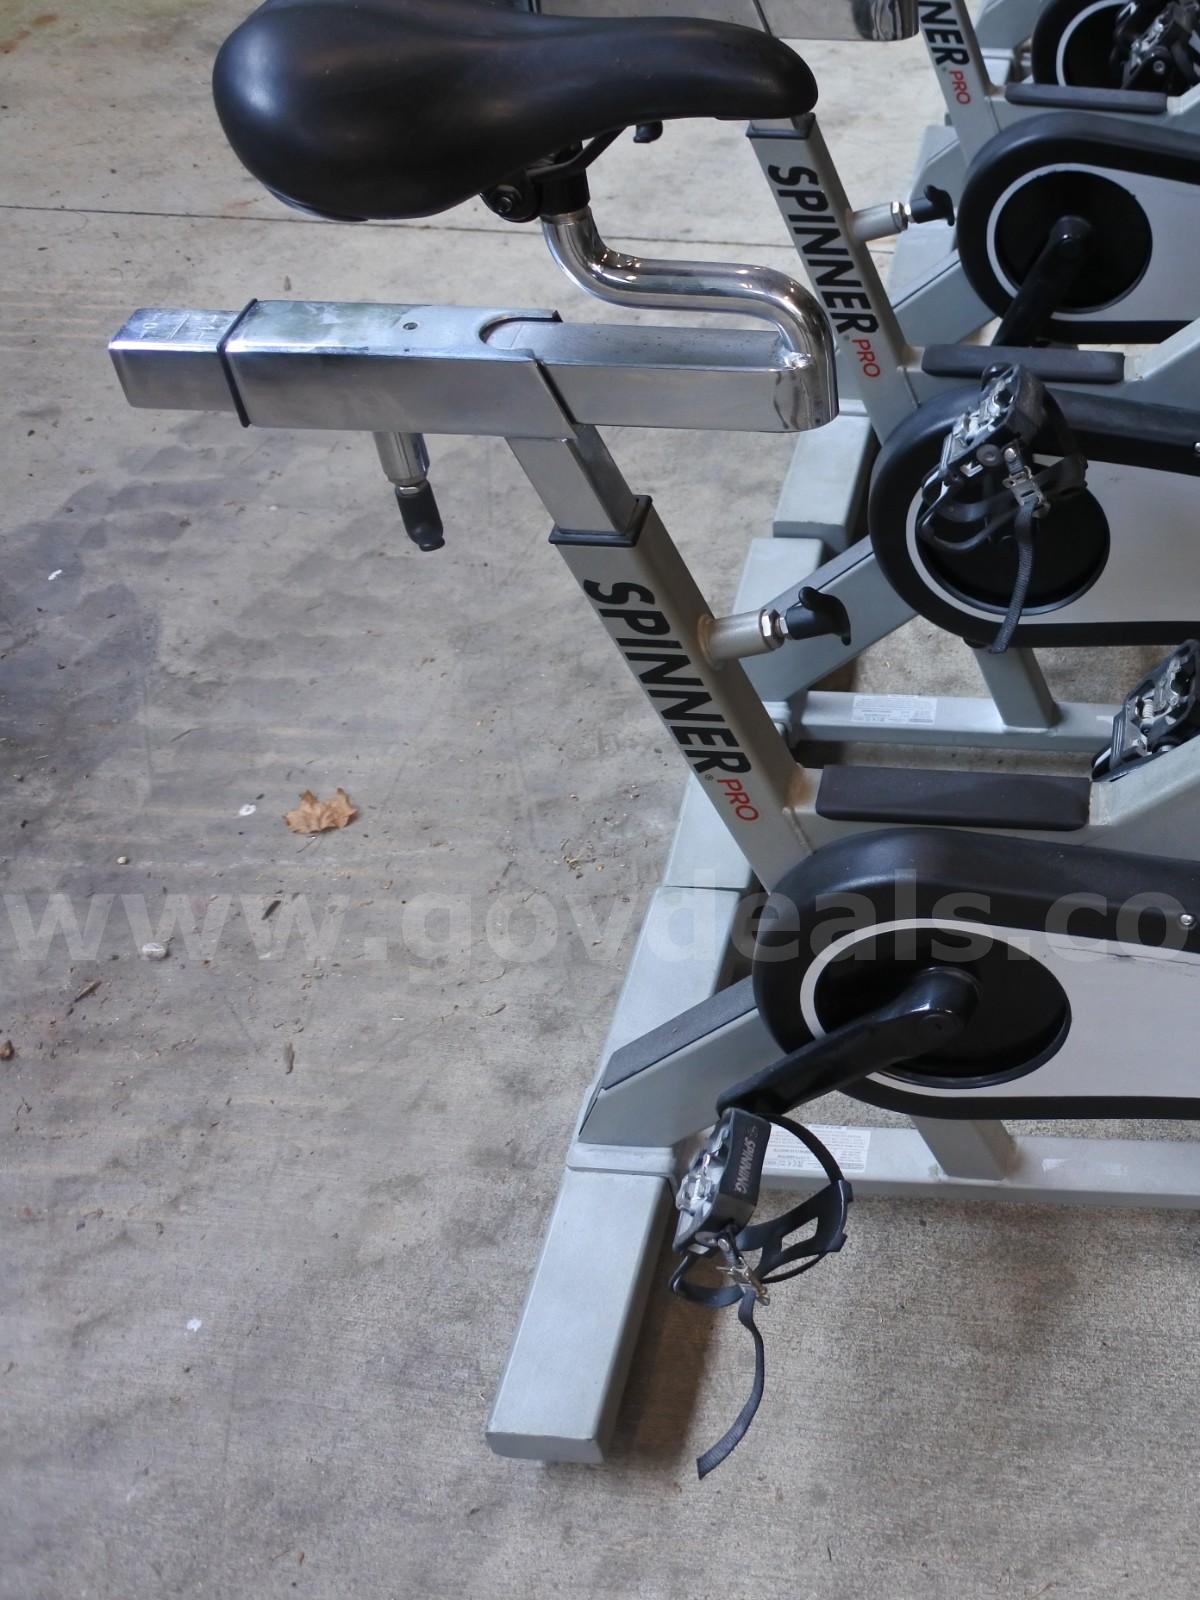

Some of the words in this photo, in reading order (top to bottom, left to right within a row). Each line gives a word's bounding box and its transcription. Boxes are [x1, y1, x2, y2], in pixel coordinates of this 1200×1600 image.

[948, 70, 971, 105] PRO
[768, 165, 879, 334] SPINNER
[852, 339, 881, 377] PRO
[583, 579, 751, 774] SPINNER
[717, 778, 759, 821] PRO
[734, 1137, 756, 1195] SPINNING
